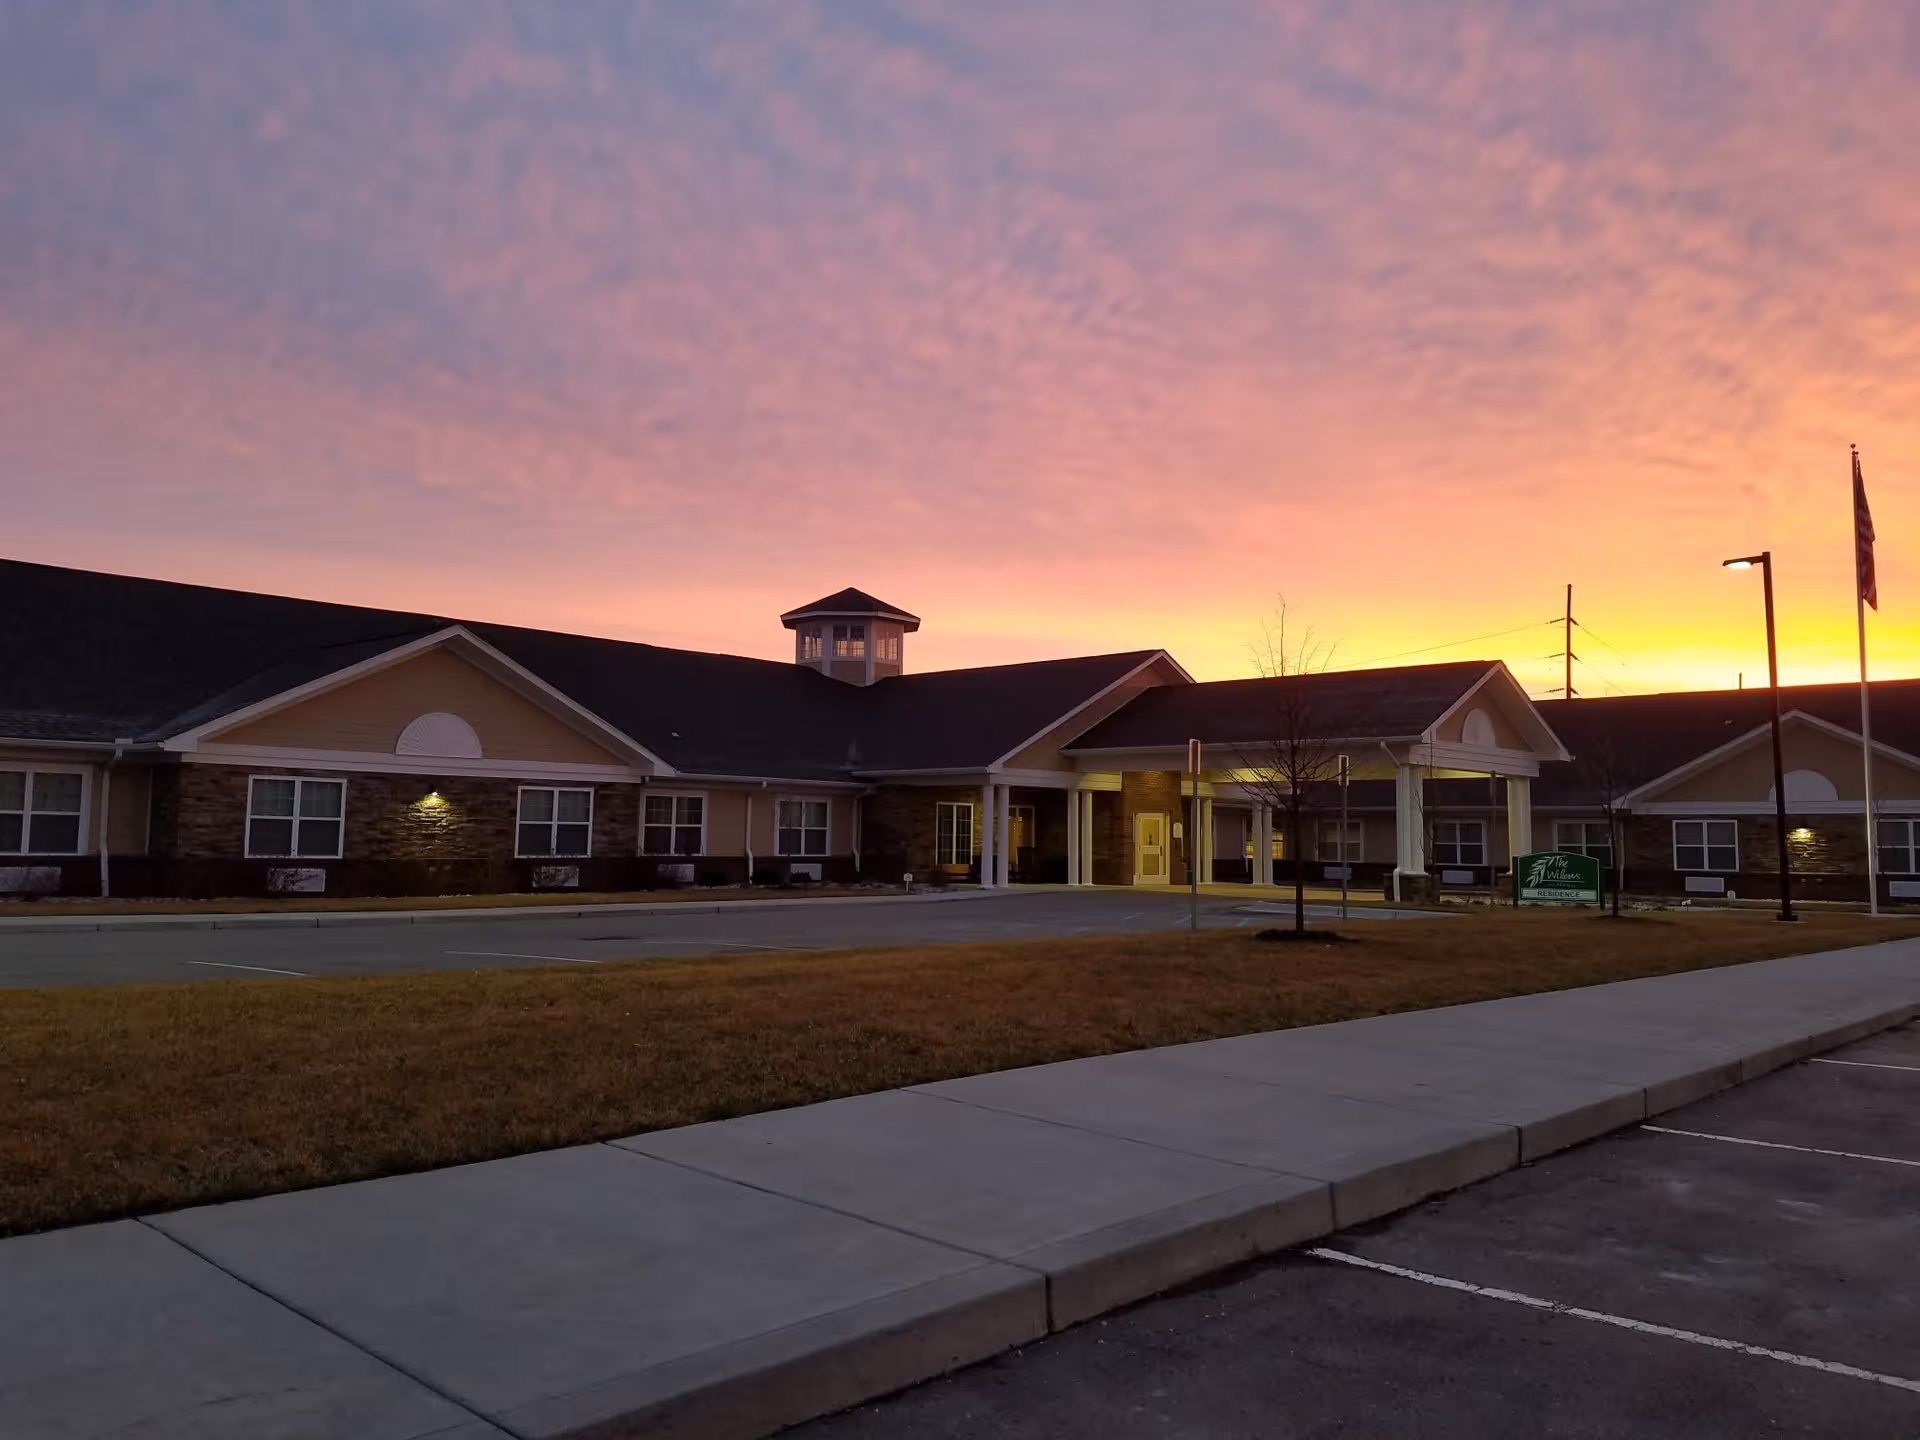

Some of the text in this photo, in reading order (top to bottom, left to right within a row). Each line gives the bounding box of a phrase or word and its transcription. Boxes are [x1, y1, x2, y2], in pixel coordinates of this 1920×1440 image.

[1553, 855, 1569, 868] The
[1546, 868, 1581, 880] Willows
[1537, 890, 1581, 898] RESIDENCE
